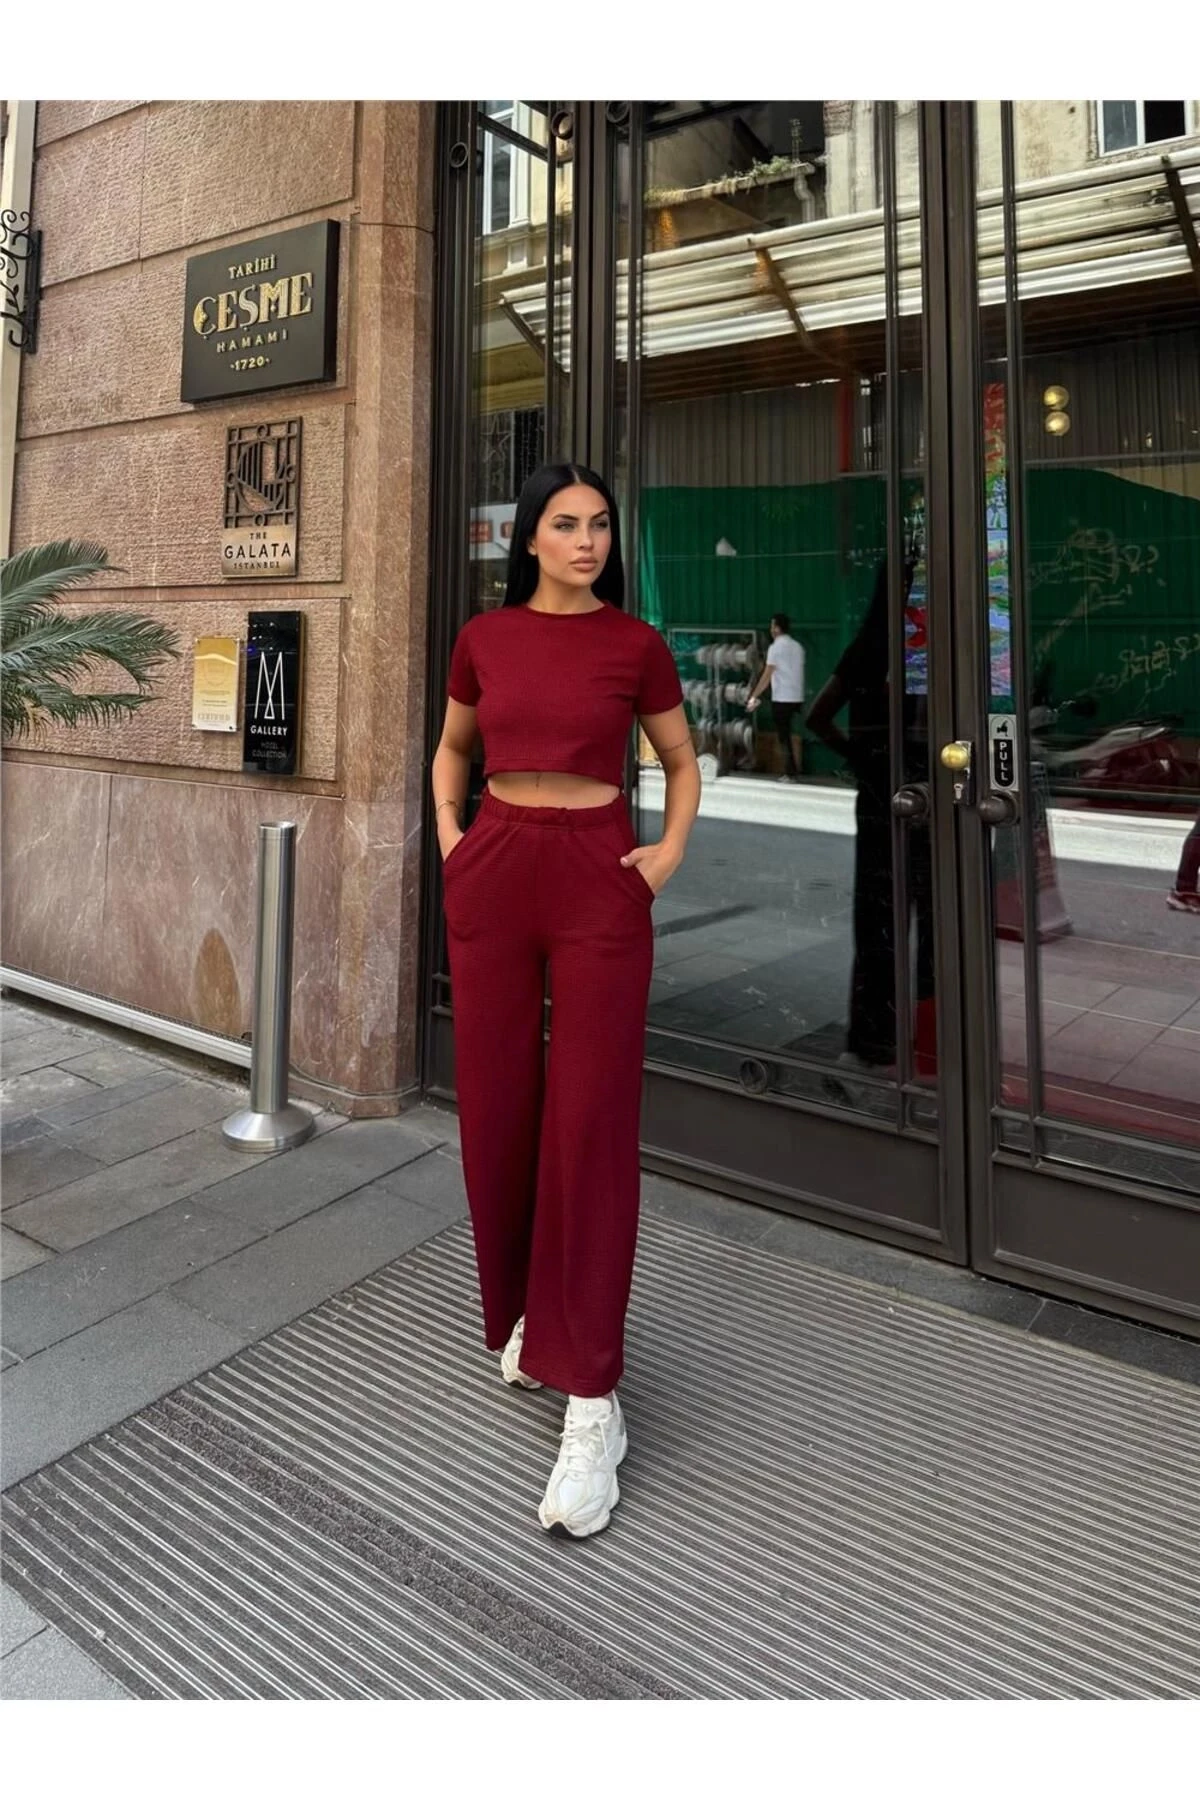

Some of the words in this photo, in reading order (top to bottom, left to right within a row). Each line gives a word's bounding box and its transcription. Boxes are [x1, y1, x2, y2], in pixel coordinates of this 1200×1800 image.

[228, 253, 276, 280] TARİHİ
[193, 272, 313, 340] ÇEŞME
[216, 328, 287, 353] HAMAMI
[249, 531, 267, 540] THE
[224, 542, 291, 559] GALATA
[250, 724, 288, 736] GALLERY
[999, 741, 1008, 781] PULL
